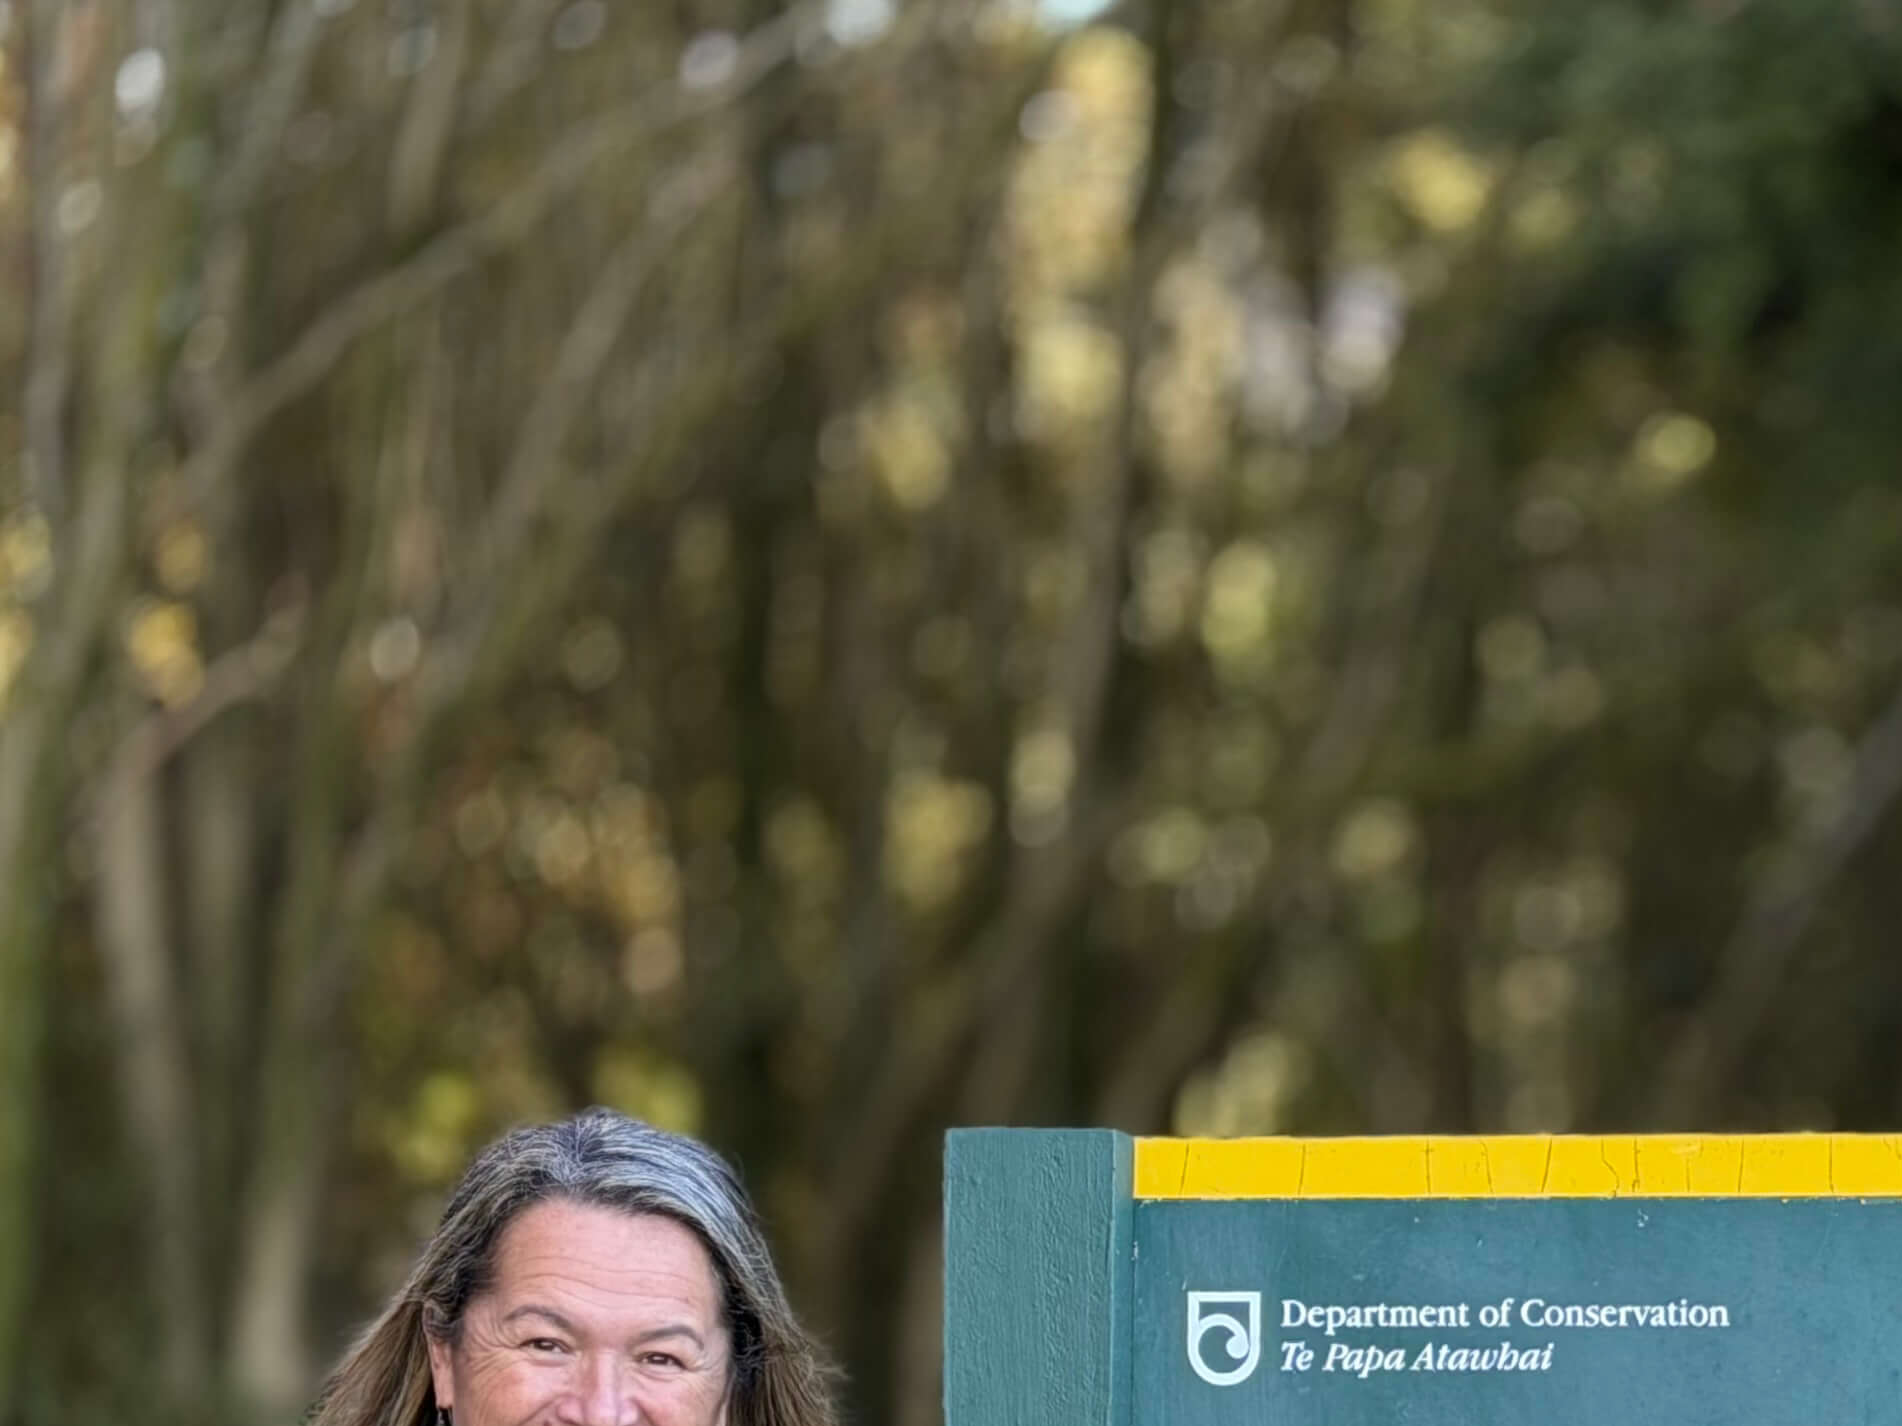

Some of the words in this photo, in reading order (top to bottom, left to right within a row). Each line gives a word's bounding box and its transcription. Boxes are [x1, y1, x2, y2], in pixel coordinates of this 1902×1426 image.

[1280, 1299, 1470, 1336] Department
[1479, 1297, 1512, 1328] of
[1519, 1298, 1731, 1328] Conservation
[1280, 1341, 1314, 1372] Te
[1321, 1342, 1405, 1379] Papa
[1411, 1340, 1555, 1372] Atawhai
